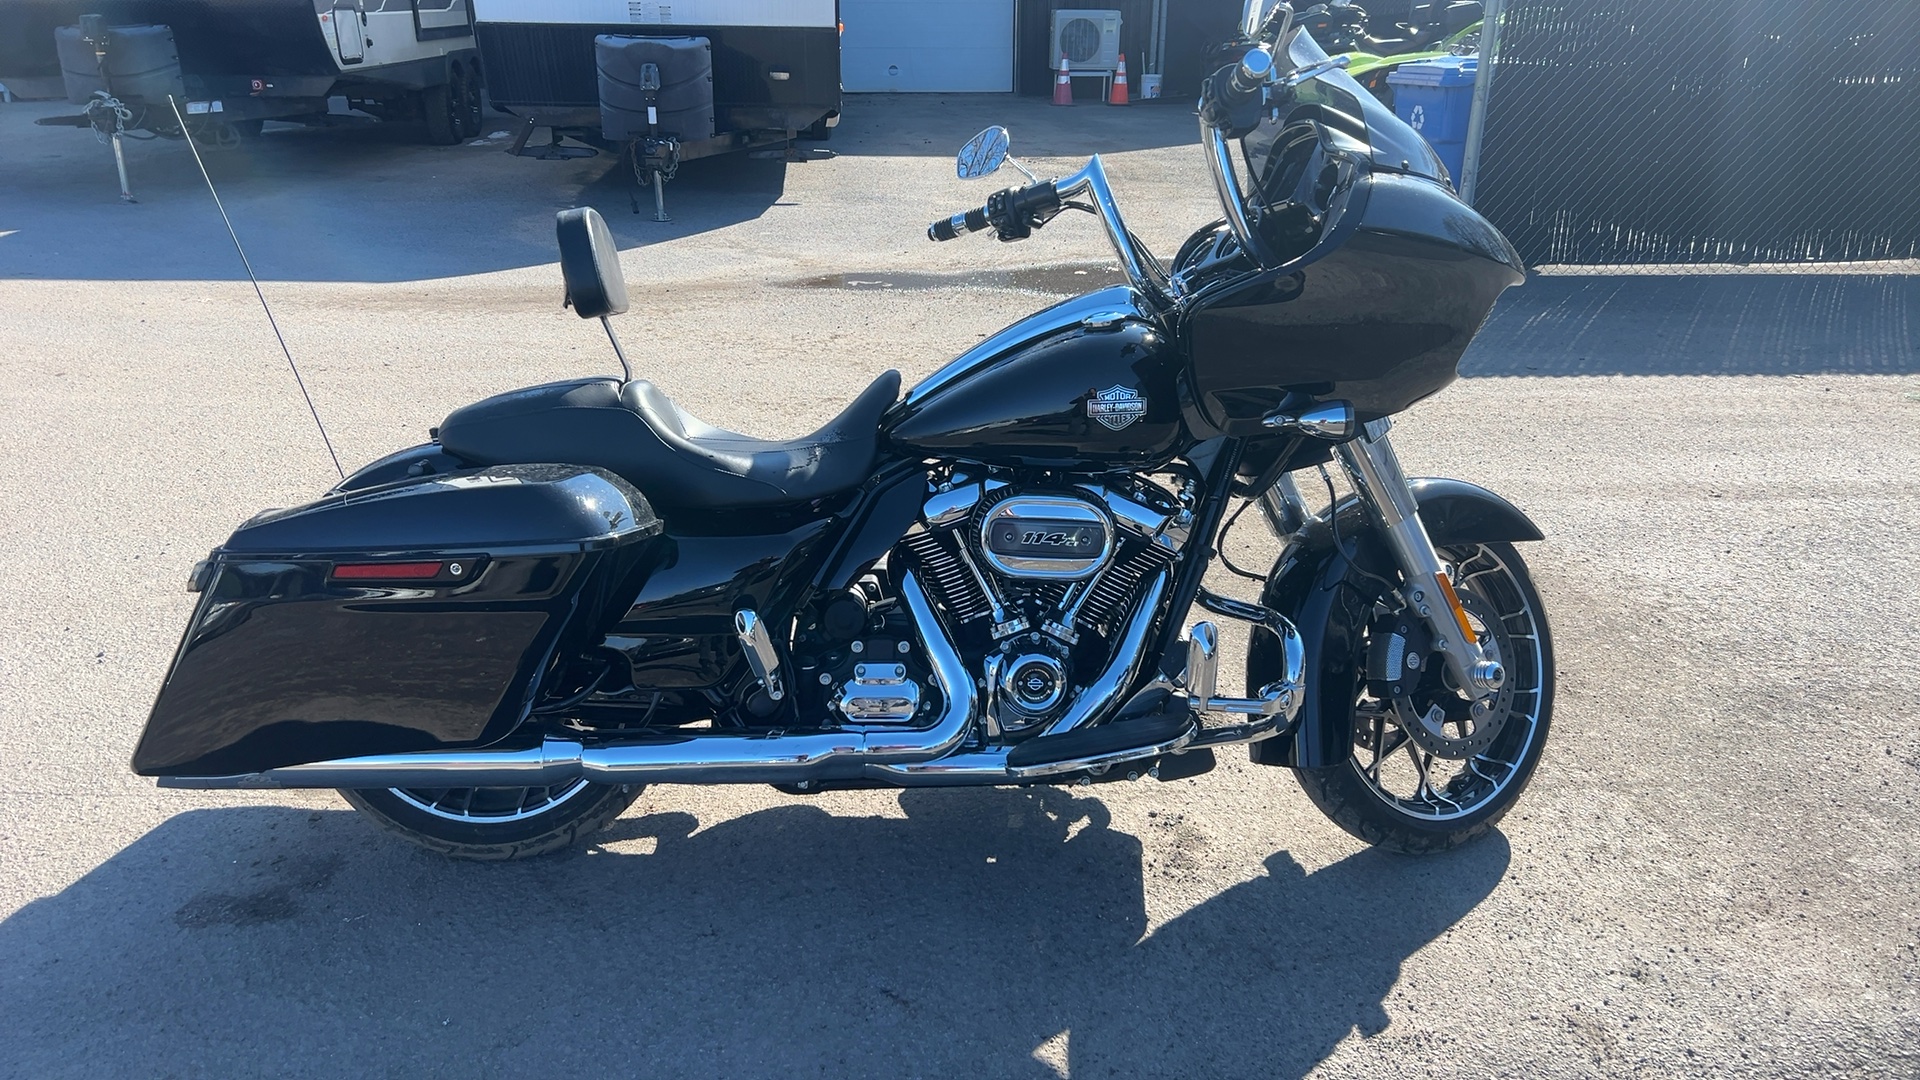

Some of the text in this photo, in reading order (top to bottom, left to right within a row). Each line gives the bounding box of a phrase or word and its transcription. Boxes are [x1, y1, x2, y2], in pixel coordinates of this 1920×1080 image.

[1104, 390, 1131, 400] MOTOR
[1092, 402, 1143, 413] HARLEY-DAVIDSON
[1103, 414, 1131, 426] CYCLES
[1021, 531, 1067, 546] 114
